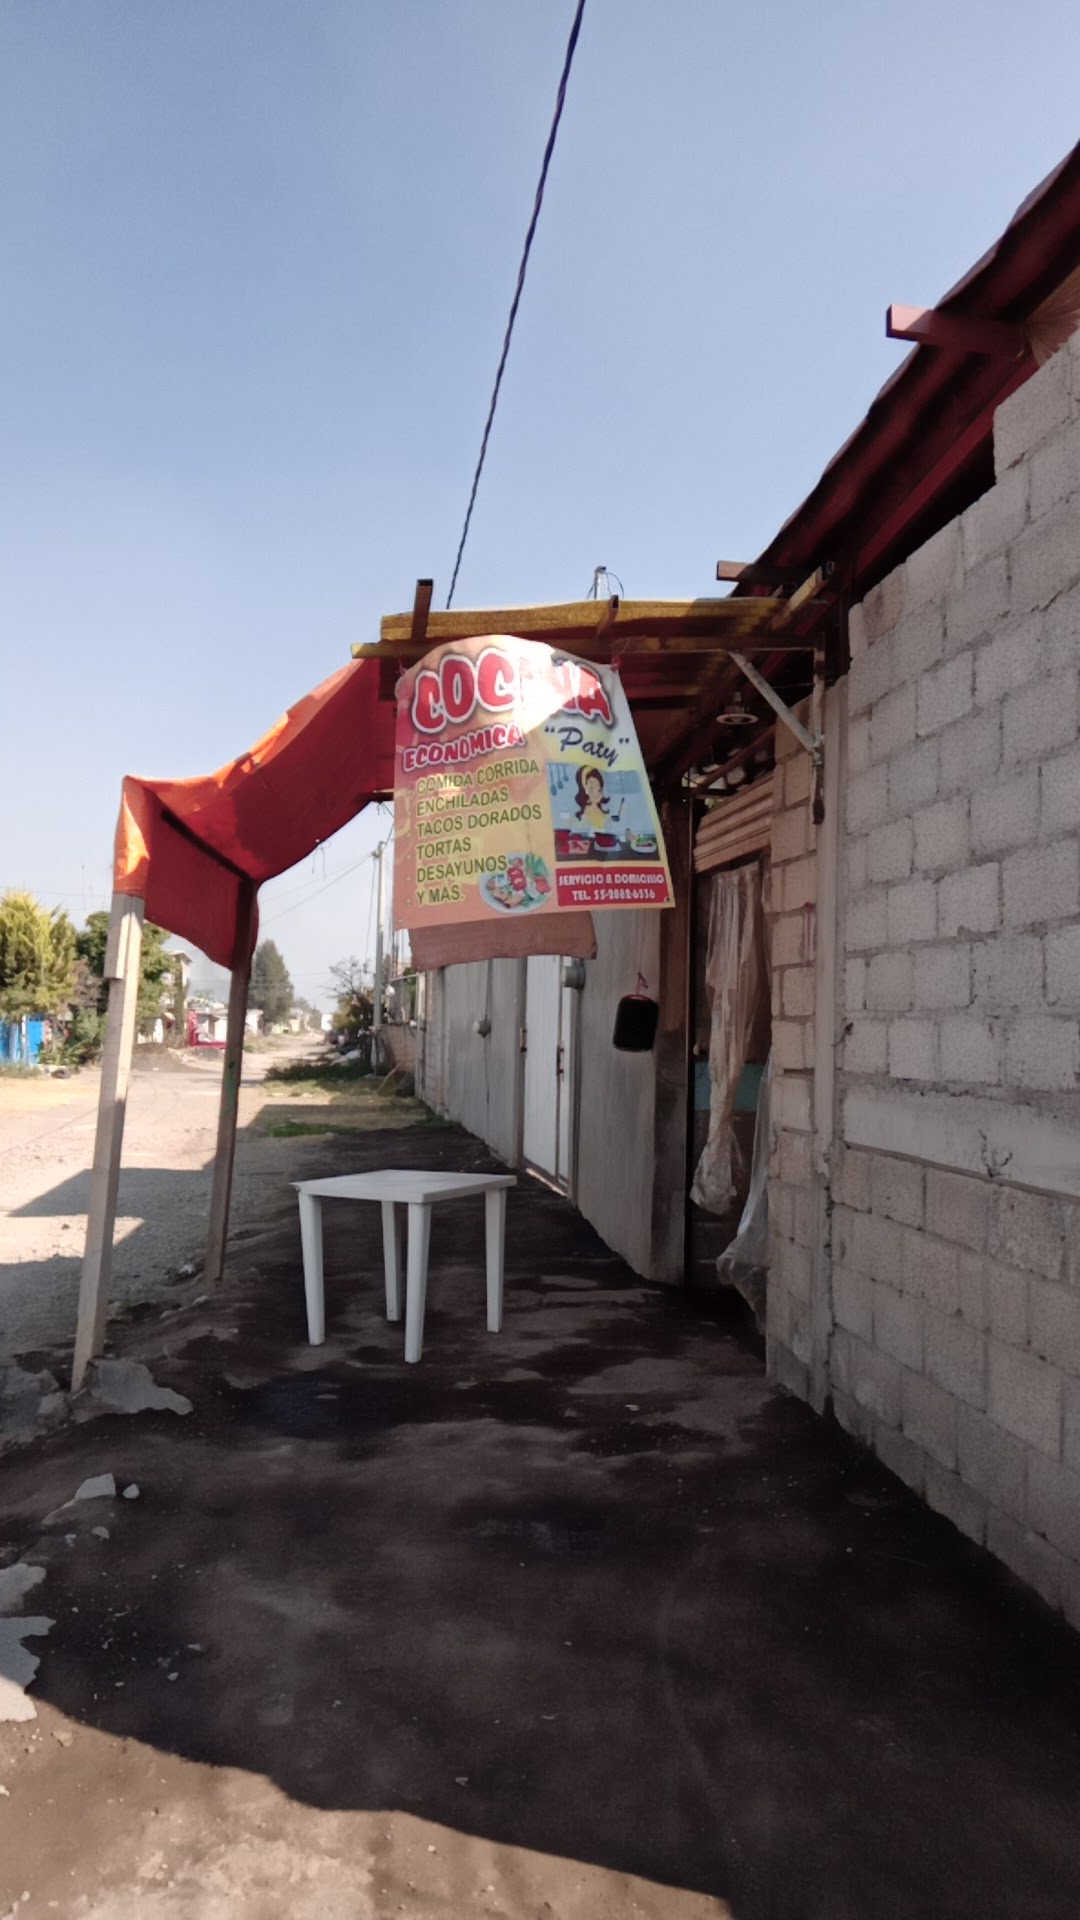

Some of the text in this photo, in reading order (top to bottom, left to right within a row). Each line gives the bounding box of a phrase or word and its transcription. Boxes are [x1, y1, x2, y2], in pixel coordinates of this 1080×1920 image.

[404, 724, 524, 770] ECONOMICA
[417, 758, 540, 793] COMIDA CORRIDA
[417, 786, 510, 816] ENCHILADAS
[417, 804, 542, 838] TACOS DORADOS
[417, 836, 472, 860] TORTAS
[417, 855, 508, 883] DESAYUNOS
[559, 873, 604, 886] SERVICIO
[614, 873, 665, 884] DOMICILIO
[417, 891, 425, 905] Y
[572, 890, 591, 901] TEL.
